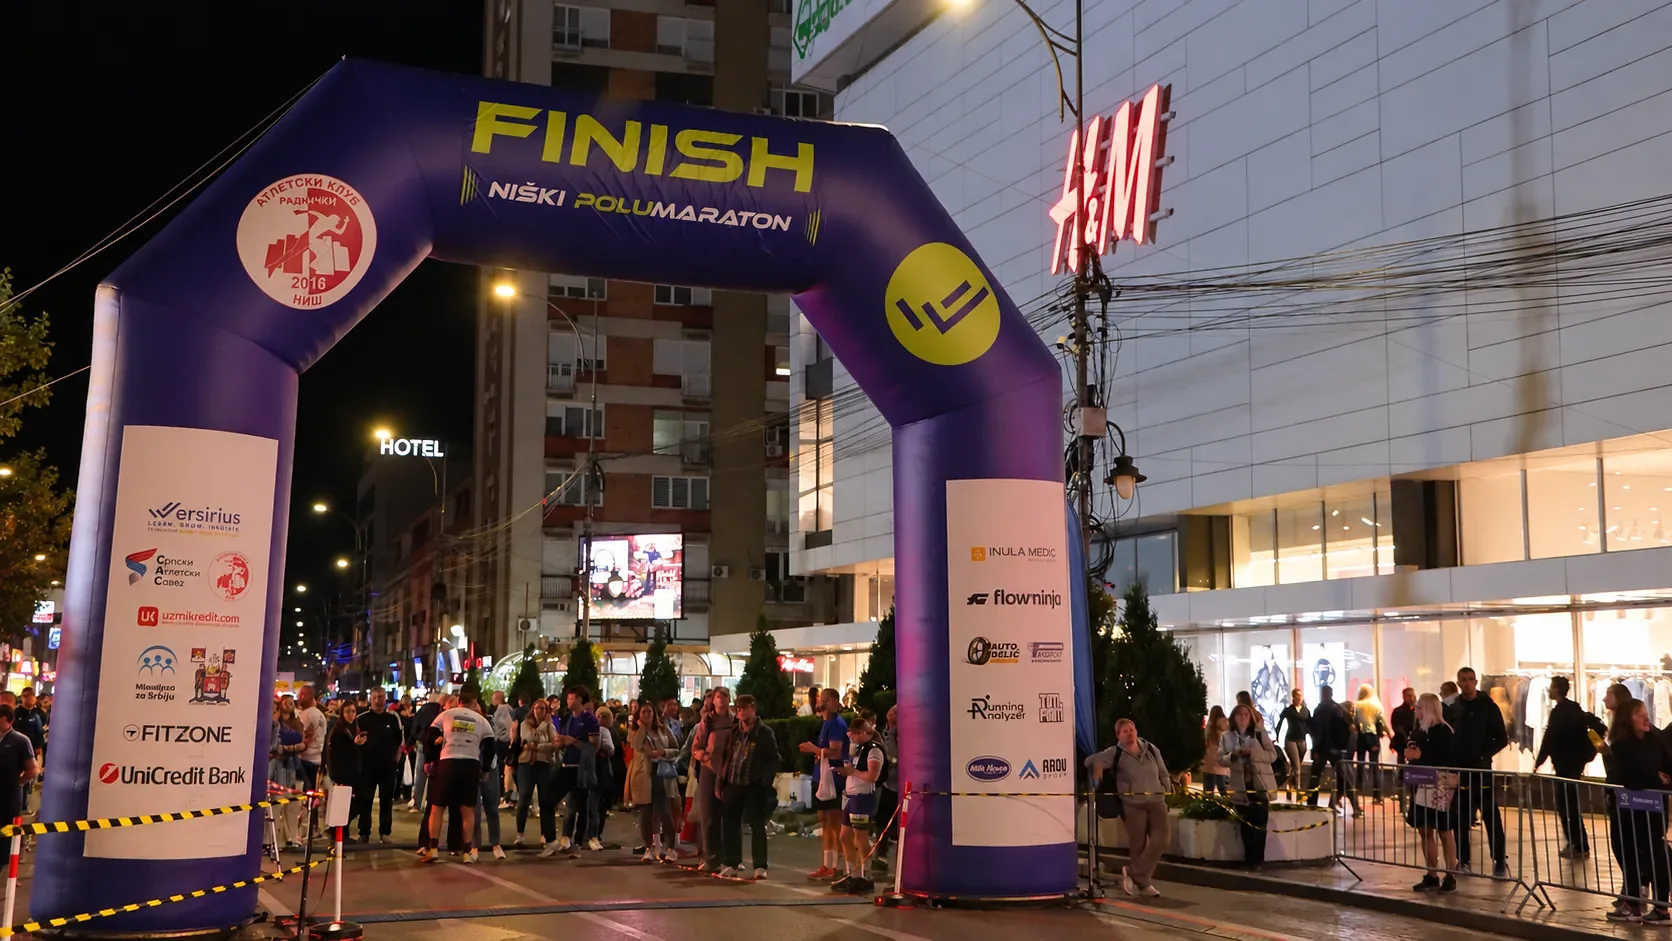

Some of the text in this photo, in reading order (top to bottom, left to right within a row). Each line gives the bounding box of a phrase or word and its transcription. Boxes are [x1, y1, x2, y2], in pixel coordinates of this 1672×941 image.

[471, 101, 815, 193] FINISH
[1049, 84, 1163, 275] H&M
[256, 177, 360, 207] АТЛЕТСКИ КЛУБ
[279, 196, 337, 207] РАДНИЧКИ
[488, 181, 792, 232] NIŠKI POLUMARATON
[291, 276, 326, 290] 2016
[292, 294, 322, 306] НИШ
[380, 438, 444, 457] HOTEL
[989, 547, 1056, 558] INULA MEDIC
[156, 555, 194, 566] Српски
[141, 610, 240, 623] UK uzmikredit.com
[991, 643, 1018, 651] AUTO
[135, 690, 175, 702] za Srbiju
[971, 697, 1024, 713] Running
[141, 724, 233, 743] FITZONE
[121, 766, 245, 785] UniCredit Bank
